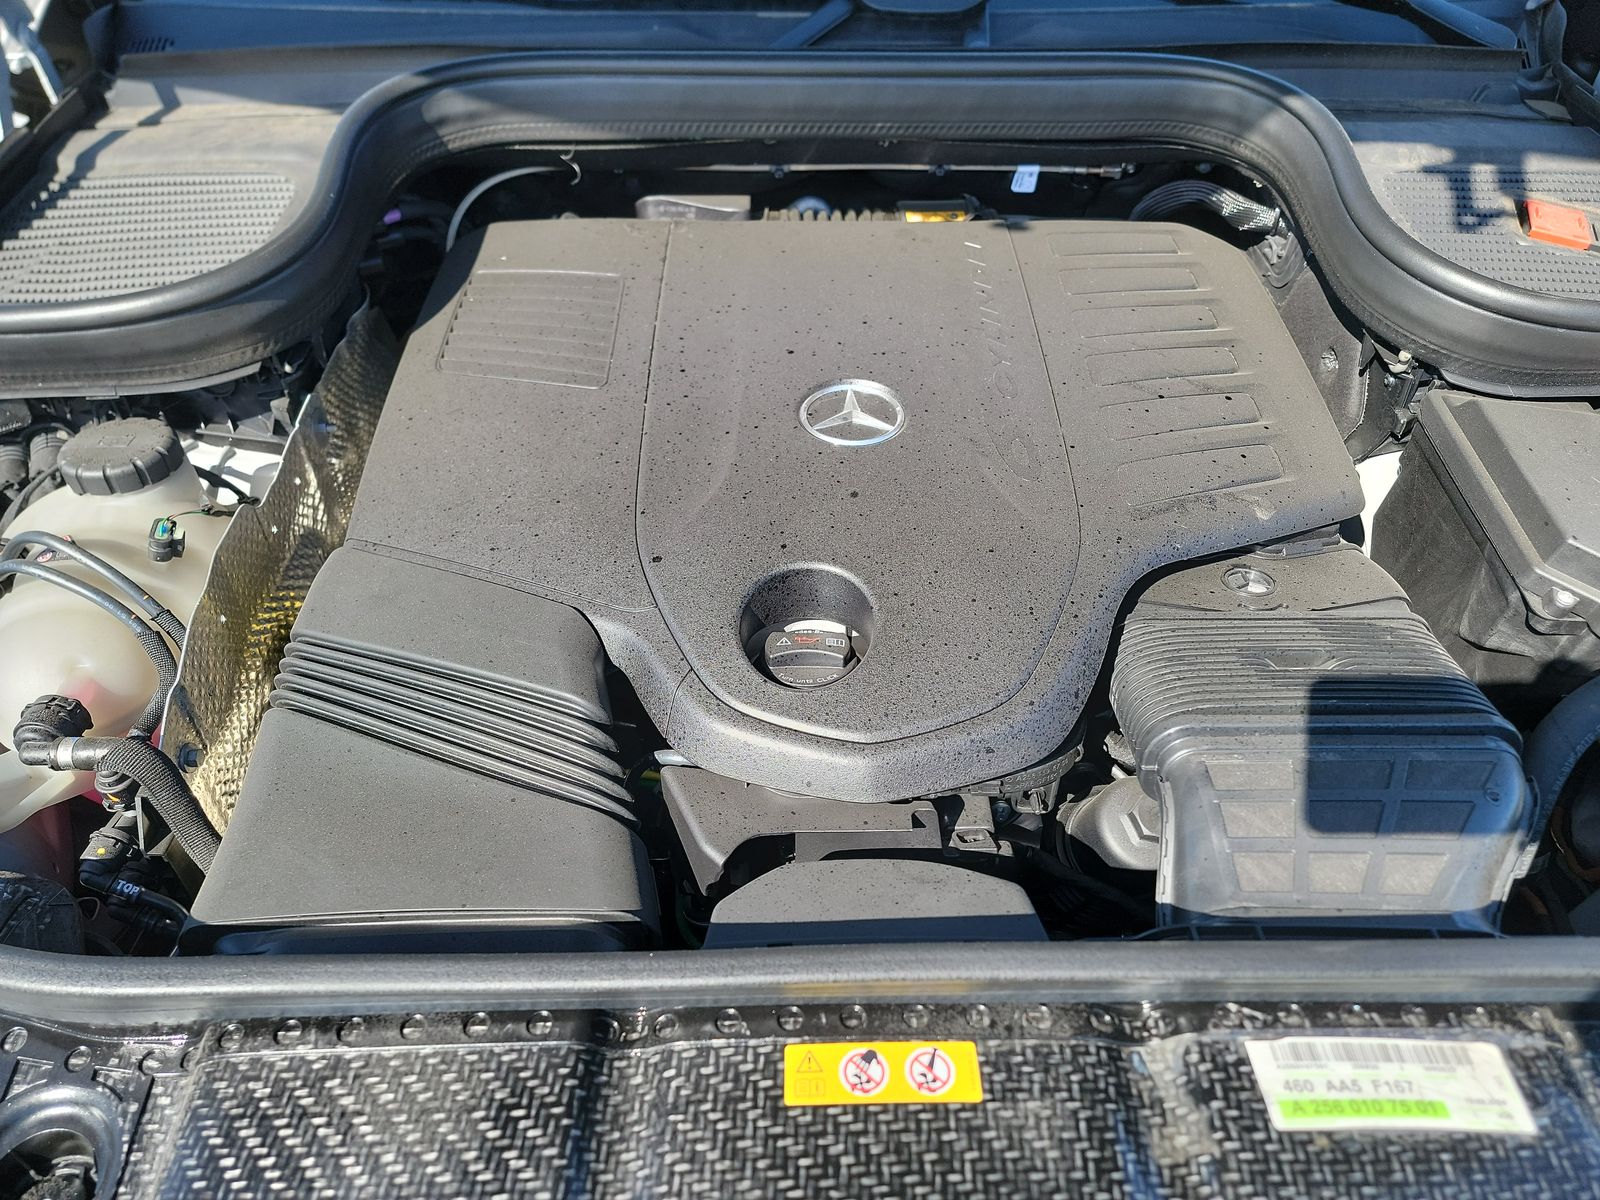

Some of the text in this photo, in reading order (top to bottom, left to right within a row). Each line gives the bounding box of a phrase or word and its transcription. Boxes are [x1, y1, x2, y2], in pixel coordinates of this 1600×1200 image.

[778, 672, 794, 682] Turn
[816, 673, 840, 683] CLICK
[116, 879, 140, 895] TOP
[1292, 1100, 1306, 1115] A
